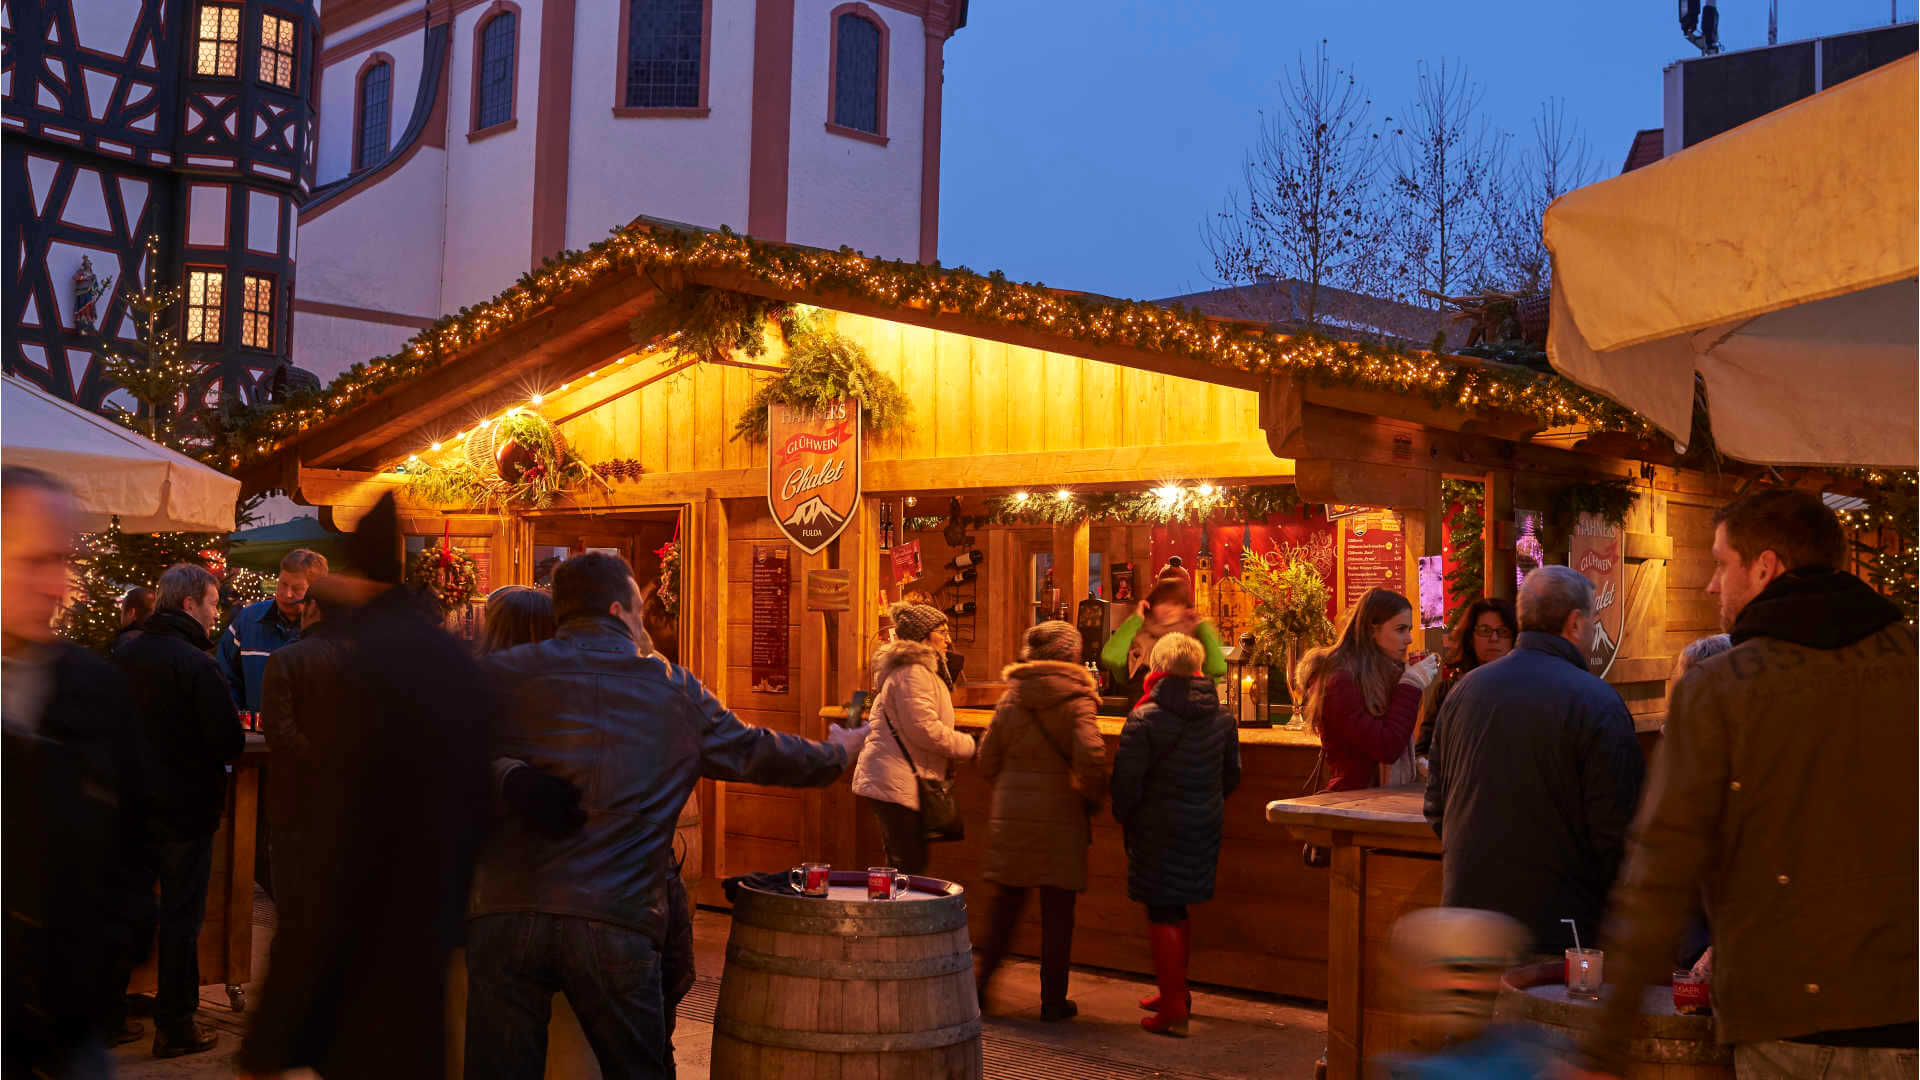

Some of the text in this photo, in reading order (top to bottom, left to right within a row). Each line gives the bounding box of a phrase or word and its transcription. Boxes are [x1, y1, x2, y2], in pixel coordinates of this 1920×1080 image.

[786, 435, 838, 455] GLÜHWEIN
[782, 458, 845, 501] Chalet
[802, 529, 822, 537] FULDA
